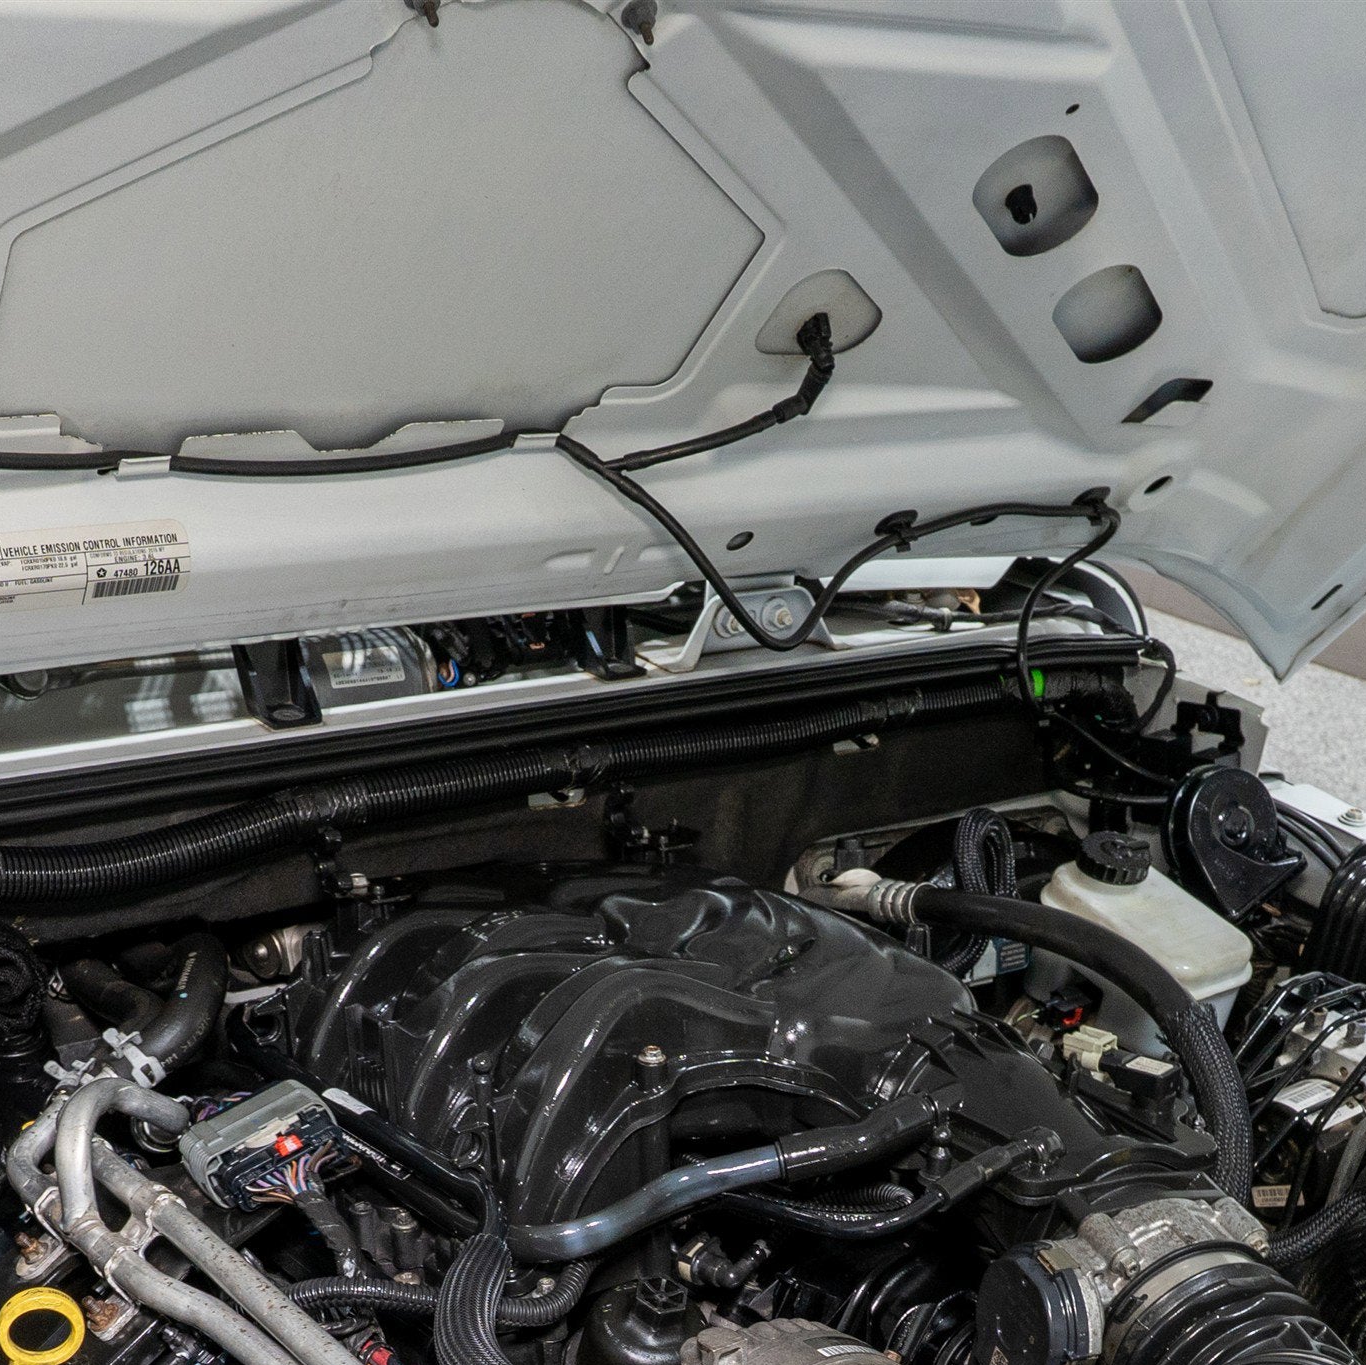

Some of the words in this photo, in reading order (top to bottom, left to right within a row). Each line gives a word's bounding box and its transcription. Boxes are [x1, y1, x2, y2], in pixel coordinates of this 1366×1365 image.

[2, 545, 37, 557] VEHICLE
[40, 541, 80, 553] EMISSION
[83, 537, 120, 550] CONTROL
[122, 532, 177, 546] INFORMATION
[113, 568, 138, 577] 47480
[143, 557, 179, 575] 126AA
